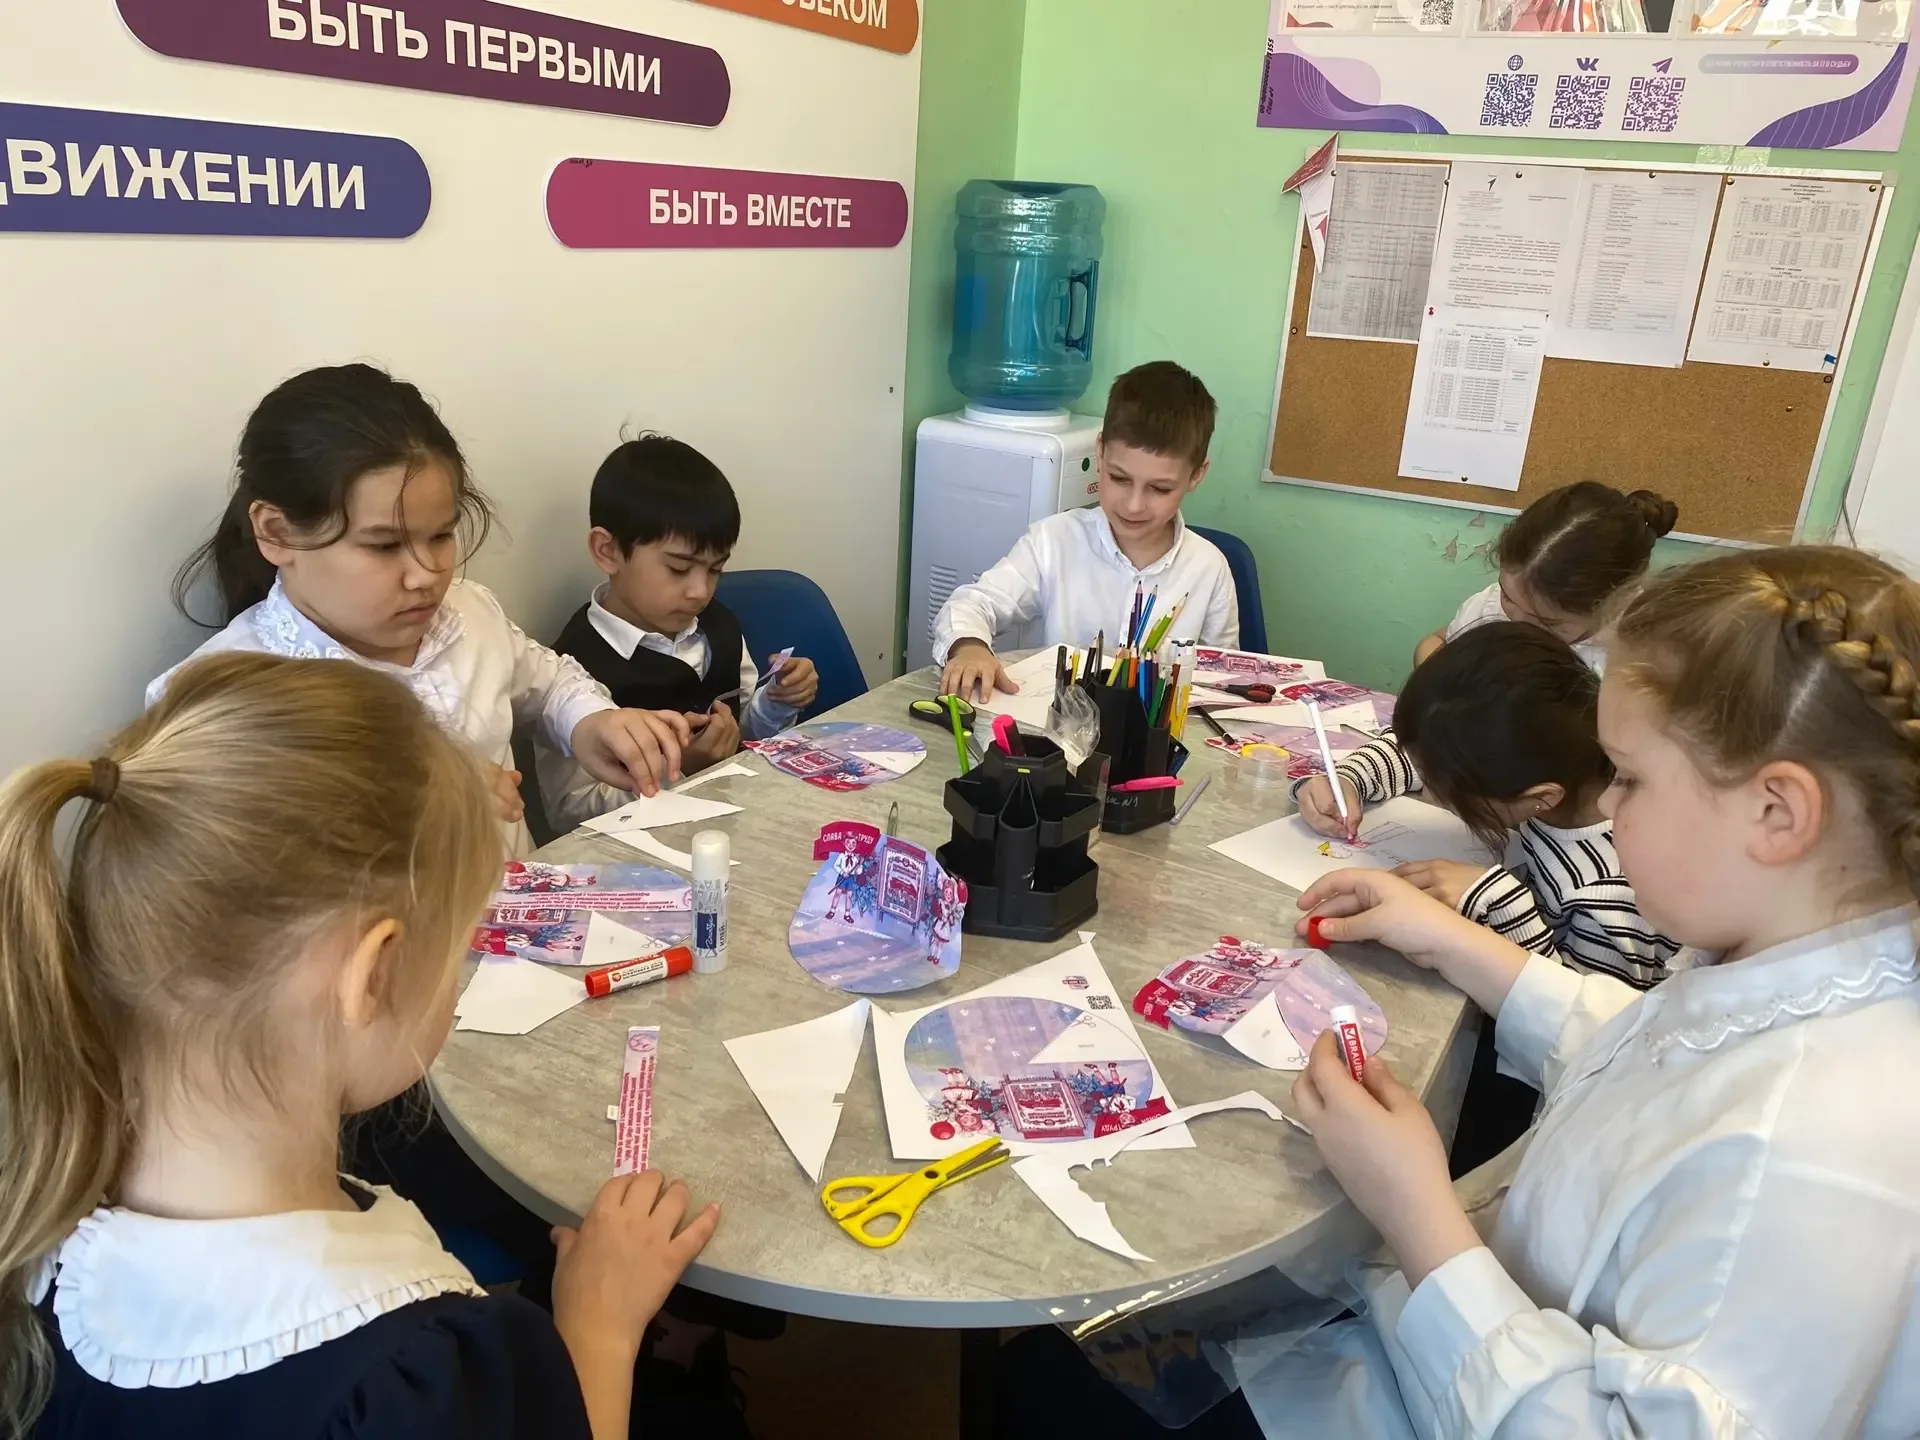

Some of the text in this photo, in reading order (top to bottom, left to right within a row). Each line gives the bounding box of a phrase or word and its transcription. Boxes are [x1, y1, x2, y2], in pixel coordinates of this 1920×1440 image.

[267, 0, 661, 95] БЫТЬ ПЕРВЫМИ
[0, 138, 366, 210] ВИЖЕНИИ
[649, 188, 852, 228] БЫТЬ ВМЕСТЕ
[822, 832, 875, 844] СЛАВА ТРУДУ
